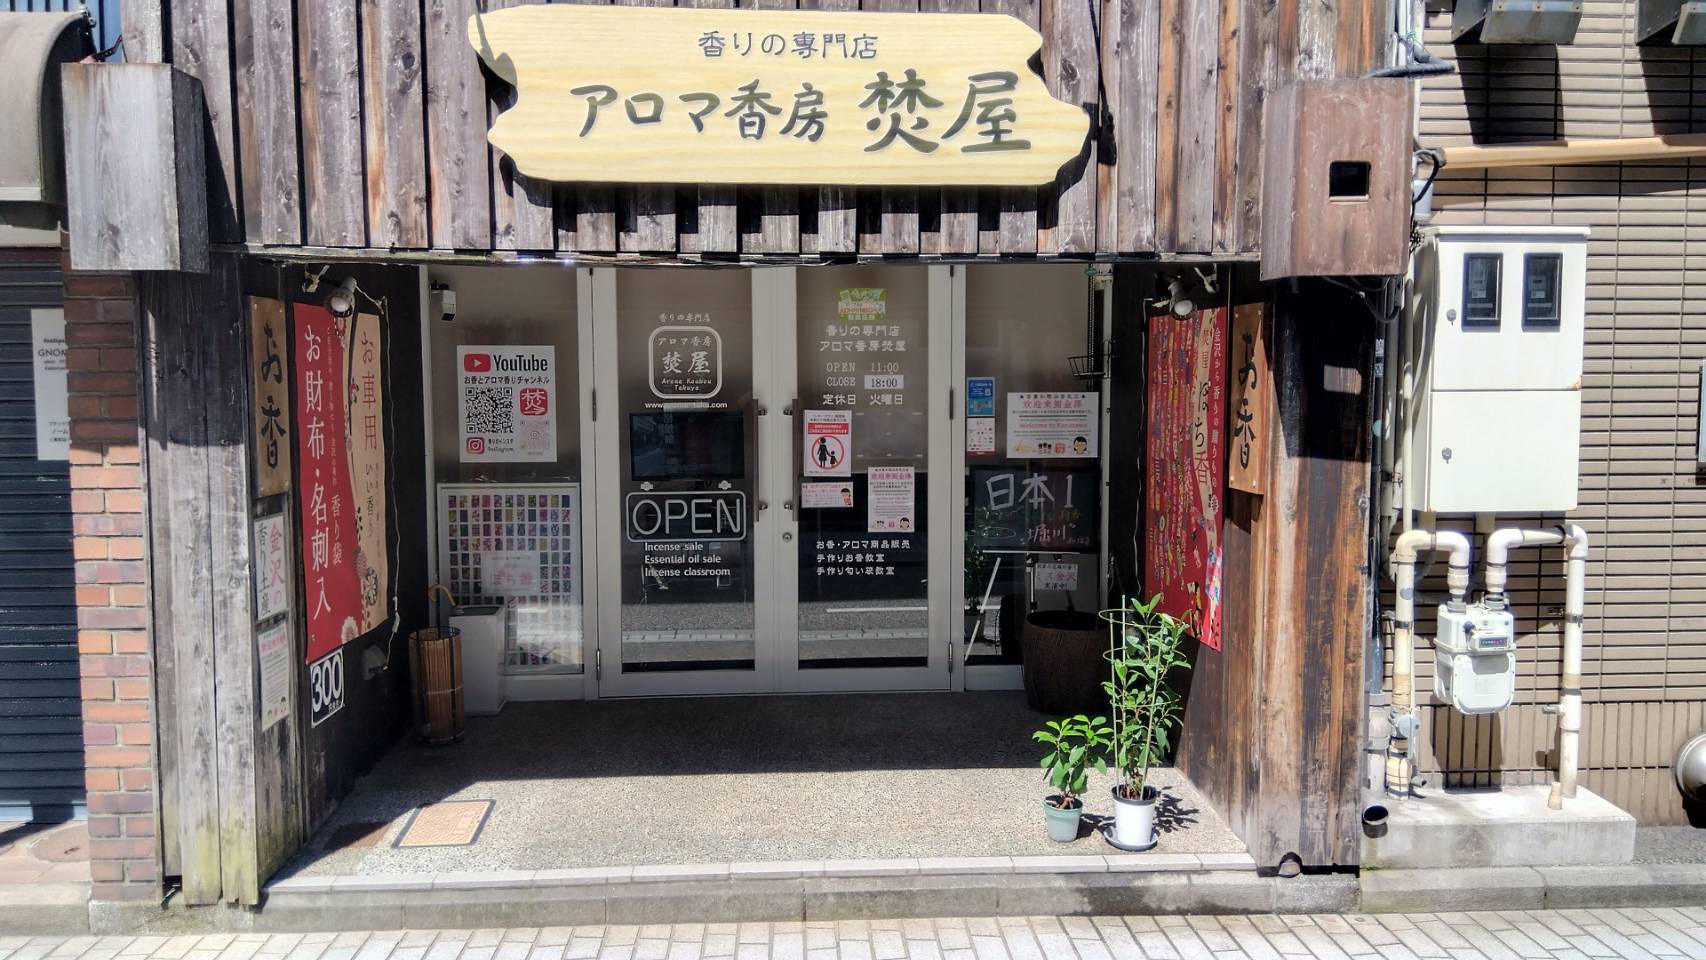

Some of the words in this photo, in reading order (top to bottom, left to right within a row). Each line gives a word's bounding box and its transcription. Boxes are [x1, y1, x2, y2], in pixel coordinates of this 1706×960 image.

[698, 30, 879, 59] 香りの専門店
[570, 78, 829, 142] アロマ香房
[858, 68, 1032, 154] 焚屋
[826, 324, 901, 337] 香りの専門店
[493, 355, 548, 372] YouTube
[661, 350, 711, 374] 焚屋
[826, 362, 856, 372] OPEN
[871, 362, 899, 372] 11:00
[826, 376, 856, 387] CLOSE
[871, 378, 898, 388] 18:00
[822, 393, 856, 405] 定休日
[869, 393, 903, 405] 火曜日
[632, 498, 741, 536] OPEN
[644, 542, 681, 551] Incense
[684, 541, 704, 551] sale
[644, 554, 686, 564] Essential
[688, 554, 700, 563] oil
[702, 554, 722, 563] sale
[644, 567, 681, 577] Incense
[684, 567, 731, 576] classroom
[312, 653, 342, 713] 300
